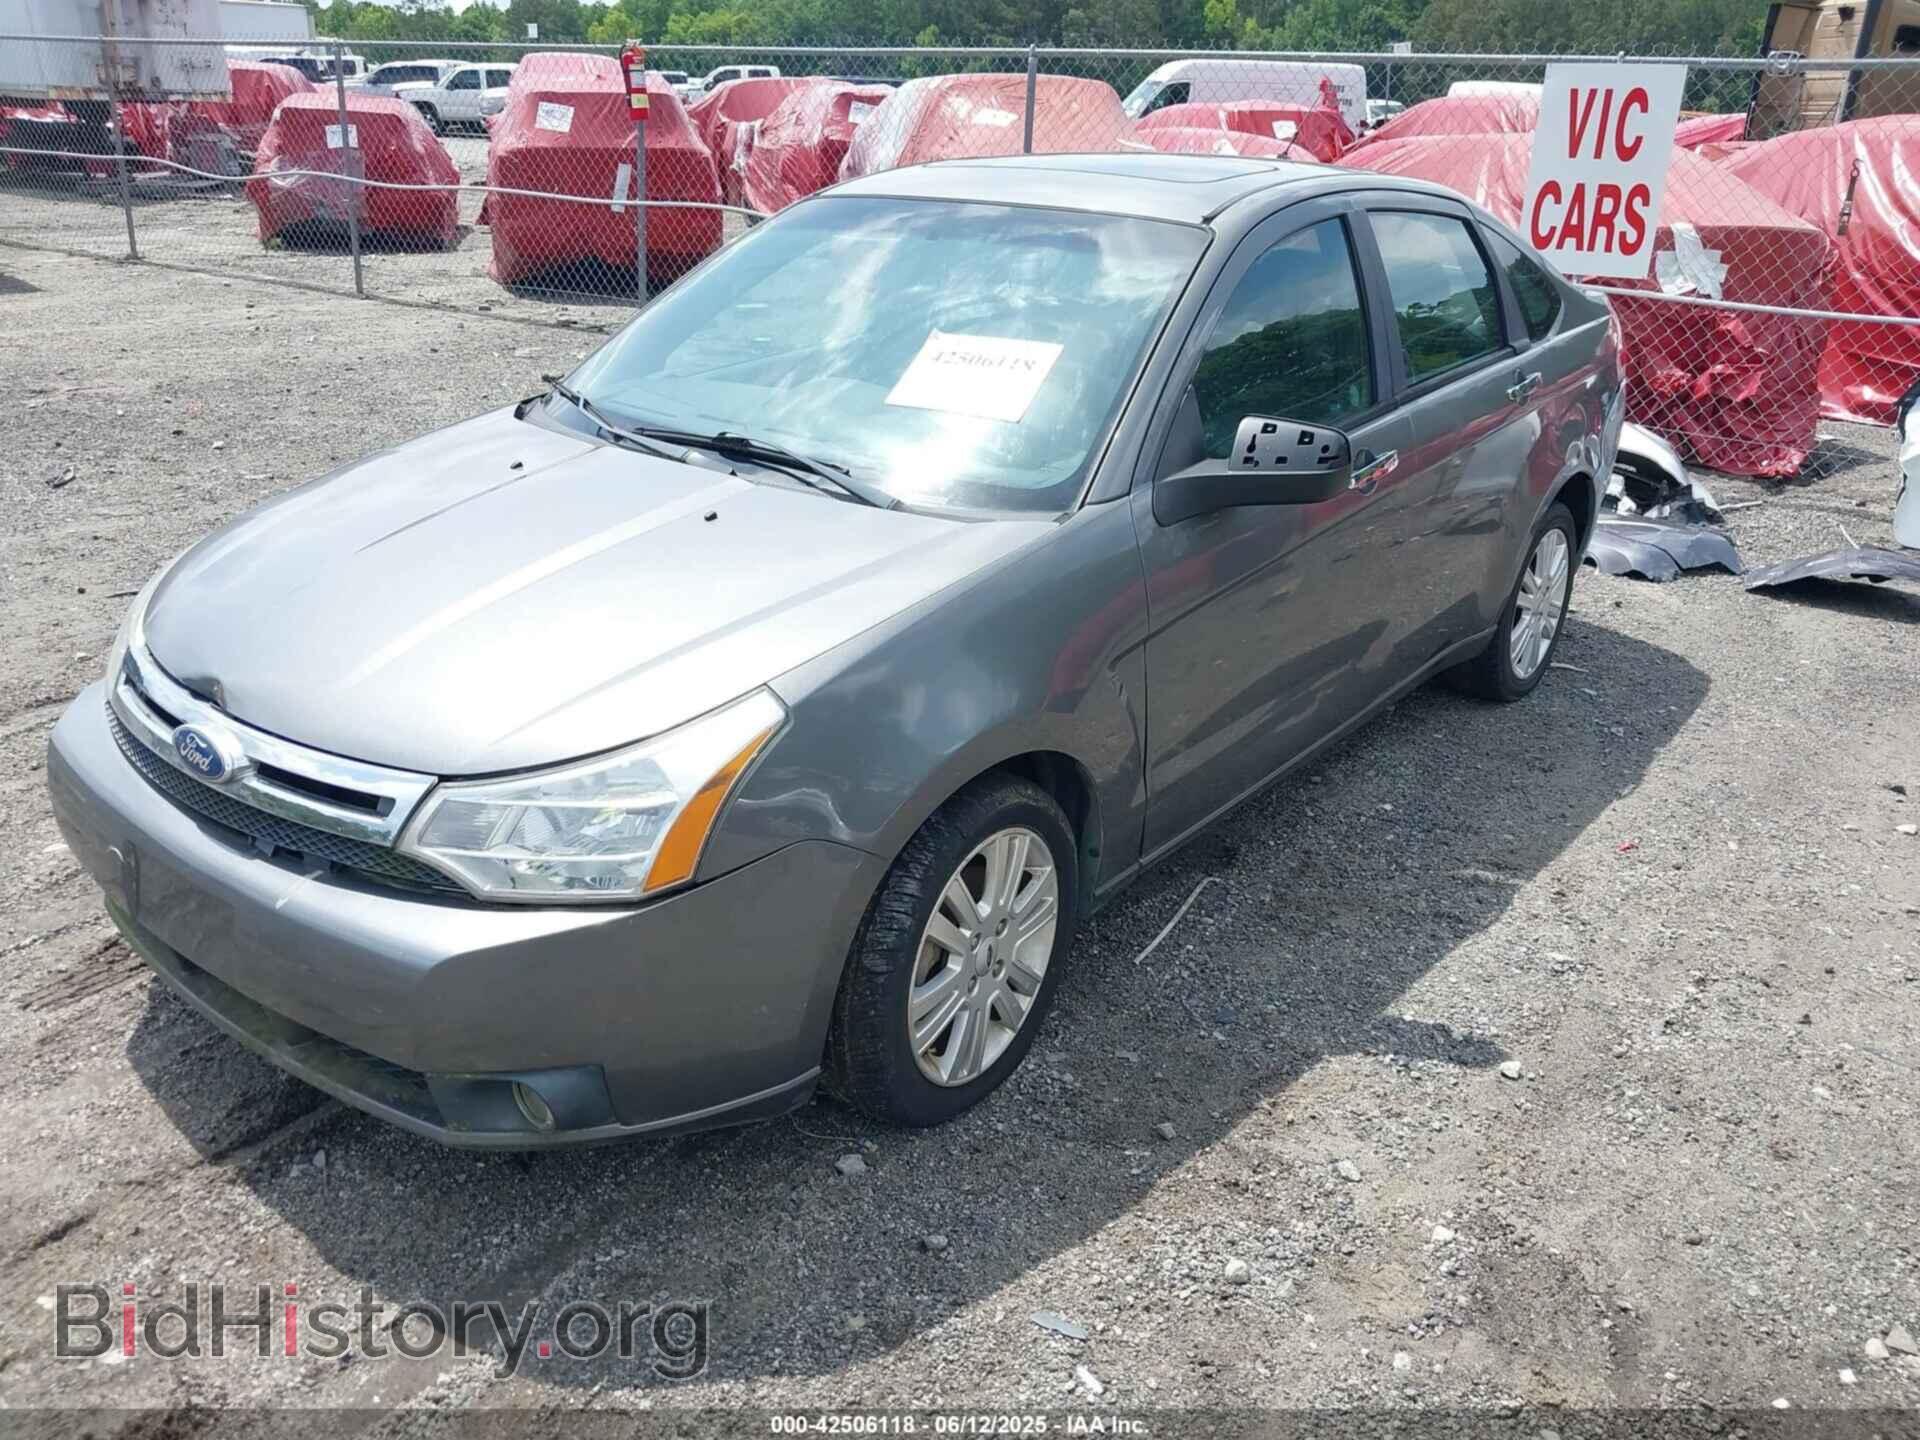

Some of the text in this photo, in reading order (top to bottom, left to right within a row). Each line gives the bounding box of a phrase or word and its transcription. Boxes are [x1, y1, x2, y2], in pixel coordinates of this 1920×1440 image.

[1568, 87, 1649, 161] VIC
[1531, 180, 1650, 256] CARS
[180, 732, 213, 771] Ford
